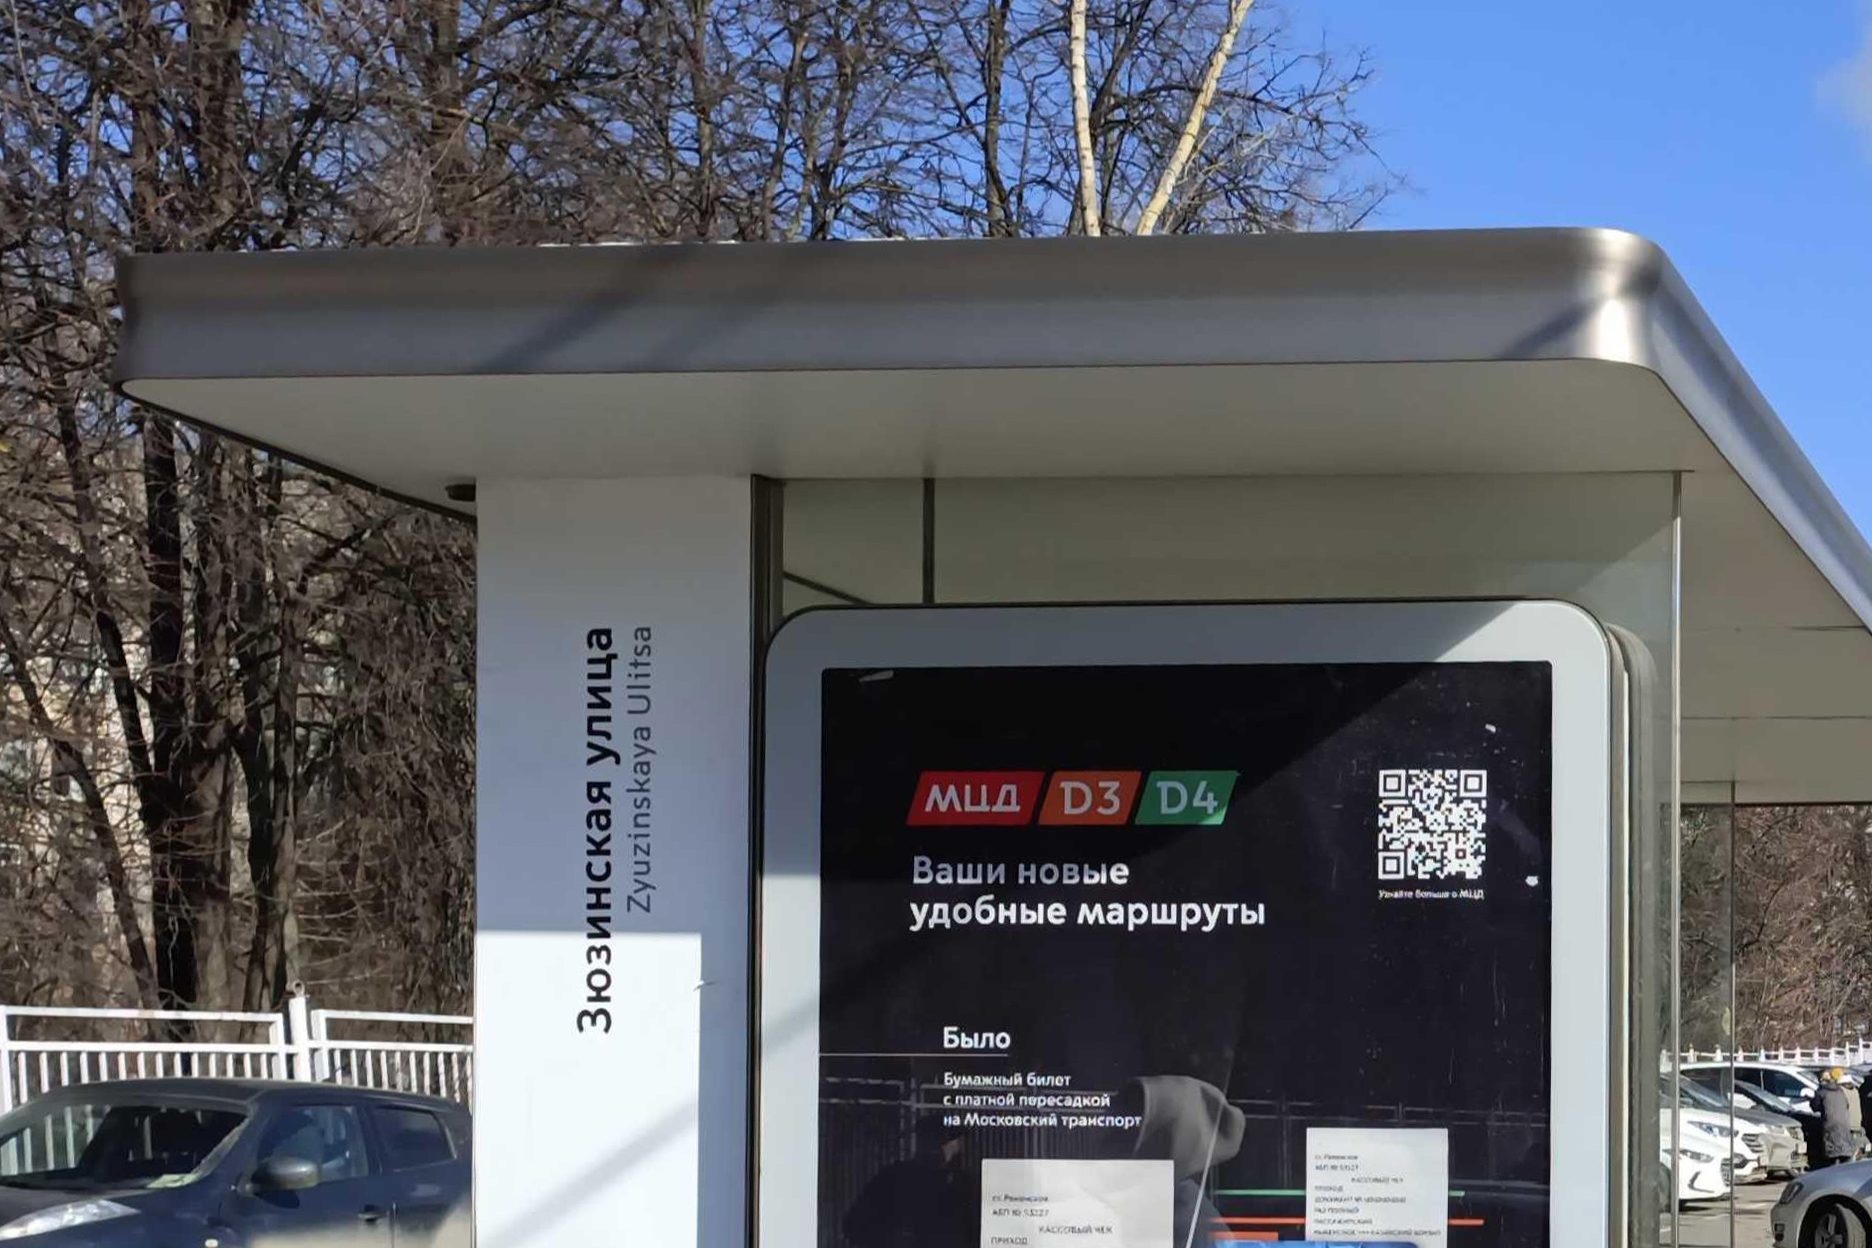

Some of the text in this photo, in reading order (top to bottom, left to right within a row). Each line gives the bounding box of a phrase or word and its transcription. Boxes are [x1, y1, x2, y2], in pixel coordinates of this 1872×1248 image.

[627, 625, 657, 913] Zyuzinskaya Ulitsa
[924, 780, 1219, 815] МЦД D3 D4
[577, 627, 621, 1033] Зюзинская улица
[913, 856, 1129, 885] Ваши новые
[909, 894, 1266, 931] удобные маршруты
[943, 1026, 1011, 1049] Было
[944, 1072, 1071, 1087] Бумажный билет
[943, 1093, 1110, 1110] с платной пересадкой
[943, 1113, 1142, 1130] на Московский транспорт
